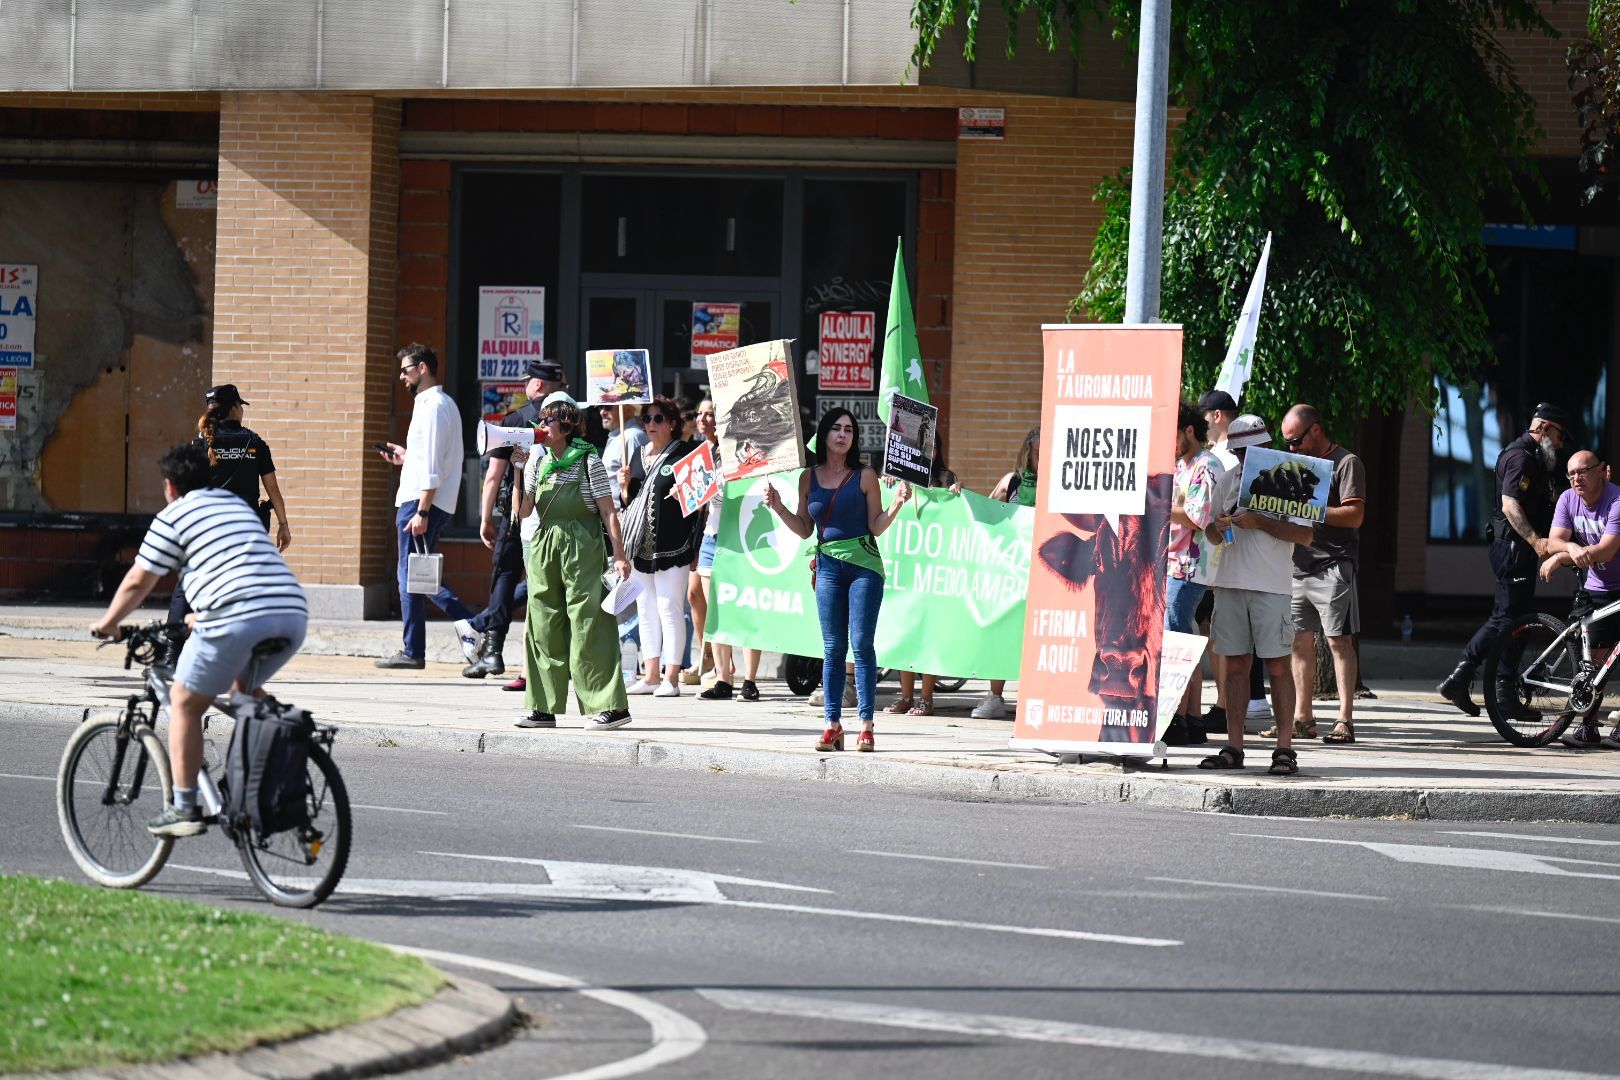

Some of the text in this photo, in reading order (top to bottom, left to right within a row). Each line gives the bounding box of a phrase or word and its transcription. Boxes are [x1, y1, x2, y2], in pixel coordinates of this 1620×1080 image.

[822, 316, 871, 339] ALQUILA
[481, 340, 540, 357] ALQUILA
[693, 337, 738, 349] OFIMÁTICA
[821, 342, 871, 364] SYNERGY
[481, 359, 498, 377] 987
[501, 359, 519, 377] 222
[820, 365, 836, 380] 987
[836, 365, 848, 380] 22
[849, 365, 860, 380] 15
[1057, 349, 1075, 374] LA
[1056, 374, 1153, 400] TAUROMAQUIA
[889, 439, 921, 457] LIBERTAD
[890, 432, 902, 443] TU
[1116, 428, 1138, 459] MI
[887, 454, 929, 474] SUFRIMIENTO
[888, 446, 912, 461] ES SU
[1061, 460, 1137, 491] CULTURA
[1248, 494, 1321, 520] ABOLICIÓN
[913, 563, 969, 597] MEDIO
[718, 582, 804, 615] PACMA
[1032, 609, 1088, 636] ¡FIRMA
[1036, 639, 1079, 673] AQUÍ!
[1047, 704, 1149, 727] NOESMICULTURA.ORG
